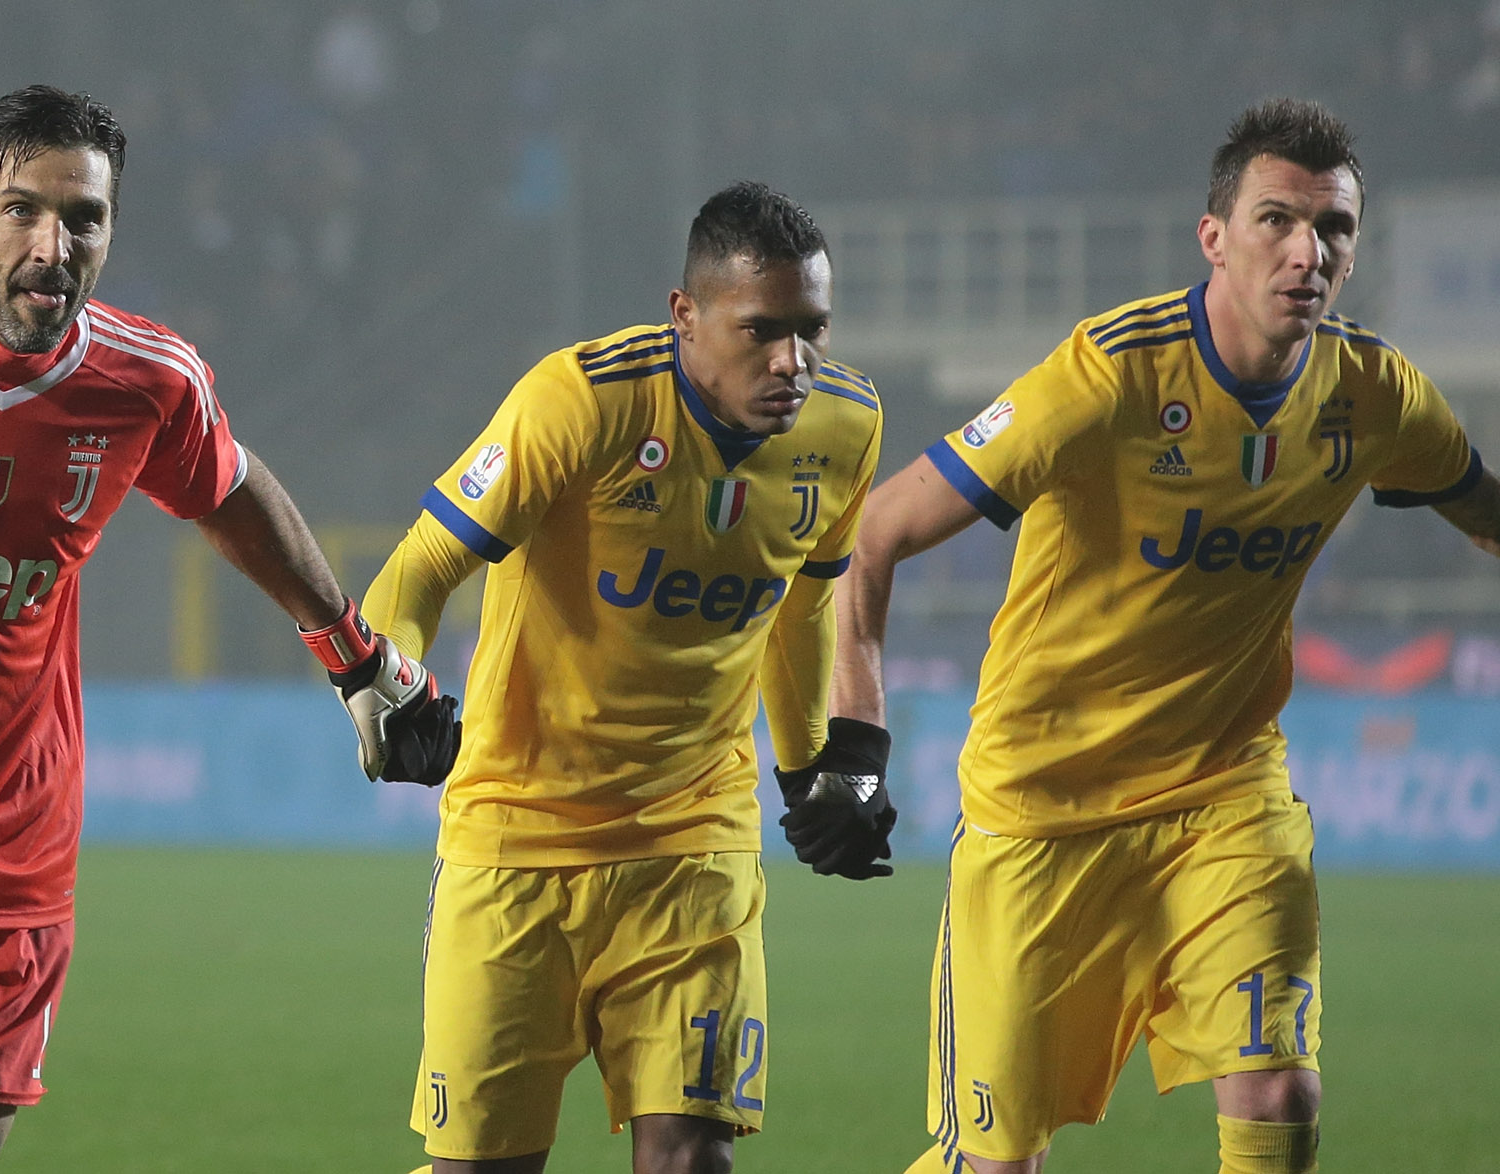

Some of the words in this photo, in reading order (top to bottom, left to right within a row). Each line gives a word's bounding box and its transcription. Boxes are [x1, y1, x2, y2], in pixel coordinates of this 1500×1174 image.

[68, 451, 102, 463] JUVENTUS
[1149, 461, 1192, 476] adidas
[466, 482, 480, 497] TIM
[617, 494, 662, 513] adidas
[1140, 508, 1323, 579] Jeep
[597, 547, 787, 632] Jeep
[1237, 972, 1314, 1057] 17
[683, 1009, 765, 1111] 12
